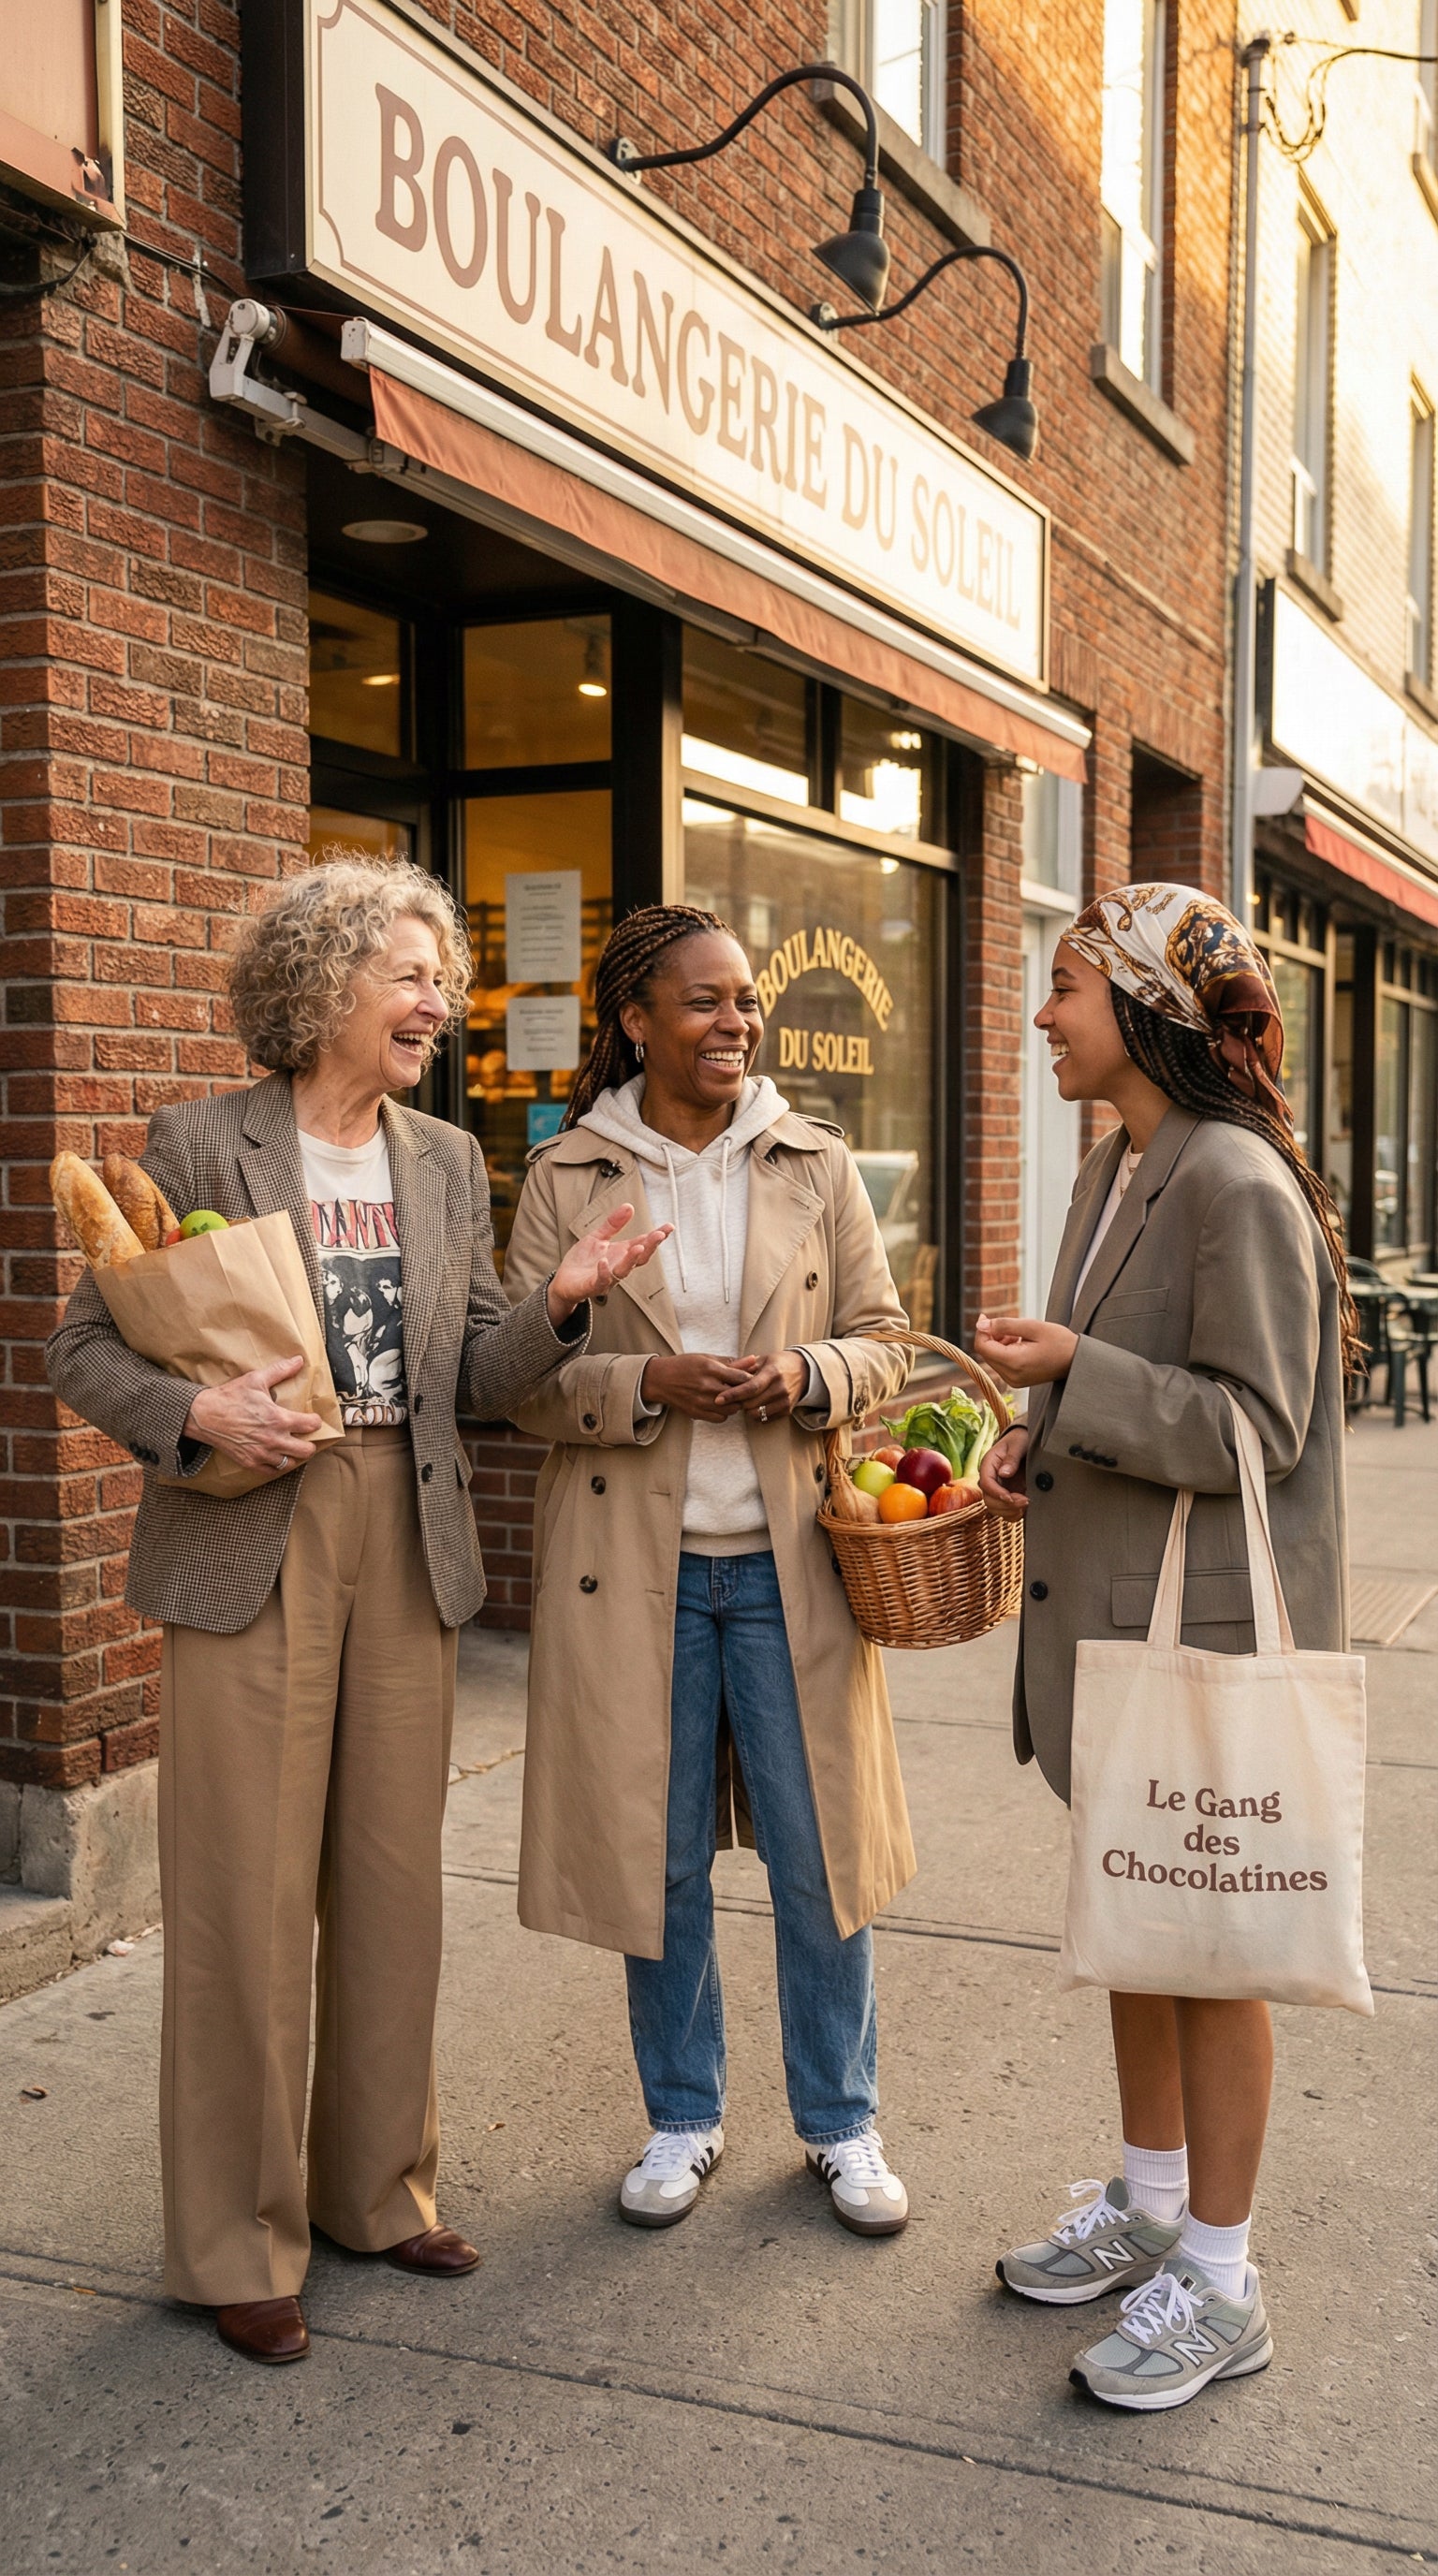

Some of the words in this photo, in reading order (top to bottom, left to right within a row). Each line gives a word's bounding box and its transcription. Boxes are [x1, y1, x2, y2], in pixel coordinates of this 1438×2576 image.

[374, 81, 828, 510] BOULANGERIE
[841, 422, 898, 552] DU
[911, 473, 1021, 632] SOLEIL
[756, 926, 893, 1032] BOULANGERIE
[779, 1027, 809, 1070] DU
[812, 1031, 874, 1076] SOLEIL
[1147, 1778, 1186, 1811] Le
[1195, 1788, 1283, 1823] Gang
[1183, 1823, 1240, 1856] des
[1102, 1849, 1328, 1894] Chocolatines
[1091, 2239, 1137, 2272] N
[1172, 2328, 1218, 2368] N
